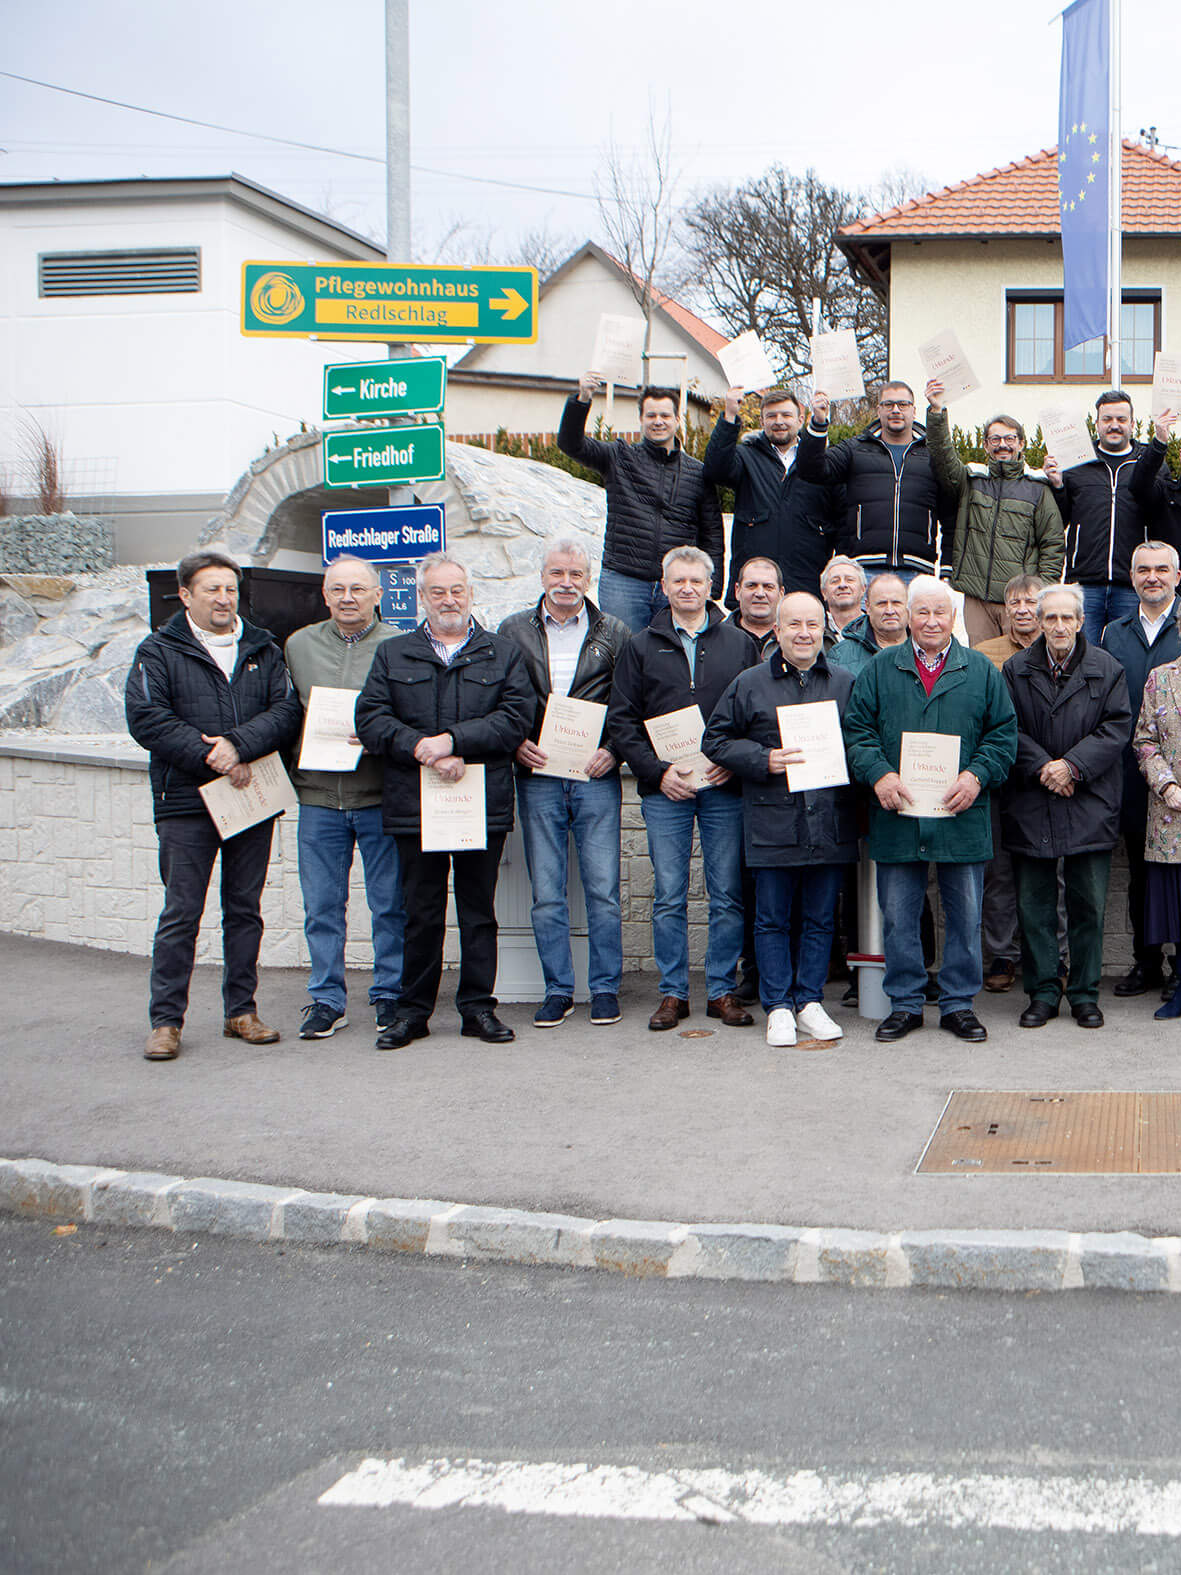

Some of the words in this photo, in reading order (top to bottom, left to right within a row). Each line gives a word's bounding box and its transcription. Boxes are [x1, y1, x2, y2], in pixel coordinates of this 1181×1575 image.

[315, 275, 479, 298] Pflegewohnhaus
[346, 304, 448, 327] Redlschlag
[359, 376, 407, 400] Kirche
[353, 443, 415, 468] Friedhof
[328, 527, 400, 550] Redlschlager
[402, 523, 439, 544] Straße
[389, 573, 398, 585] S
[402, 577, 416, 585] 100
[664, 736, 698, 752] Urkunde
[911, 759, 947, 773] Urkunde
